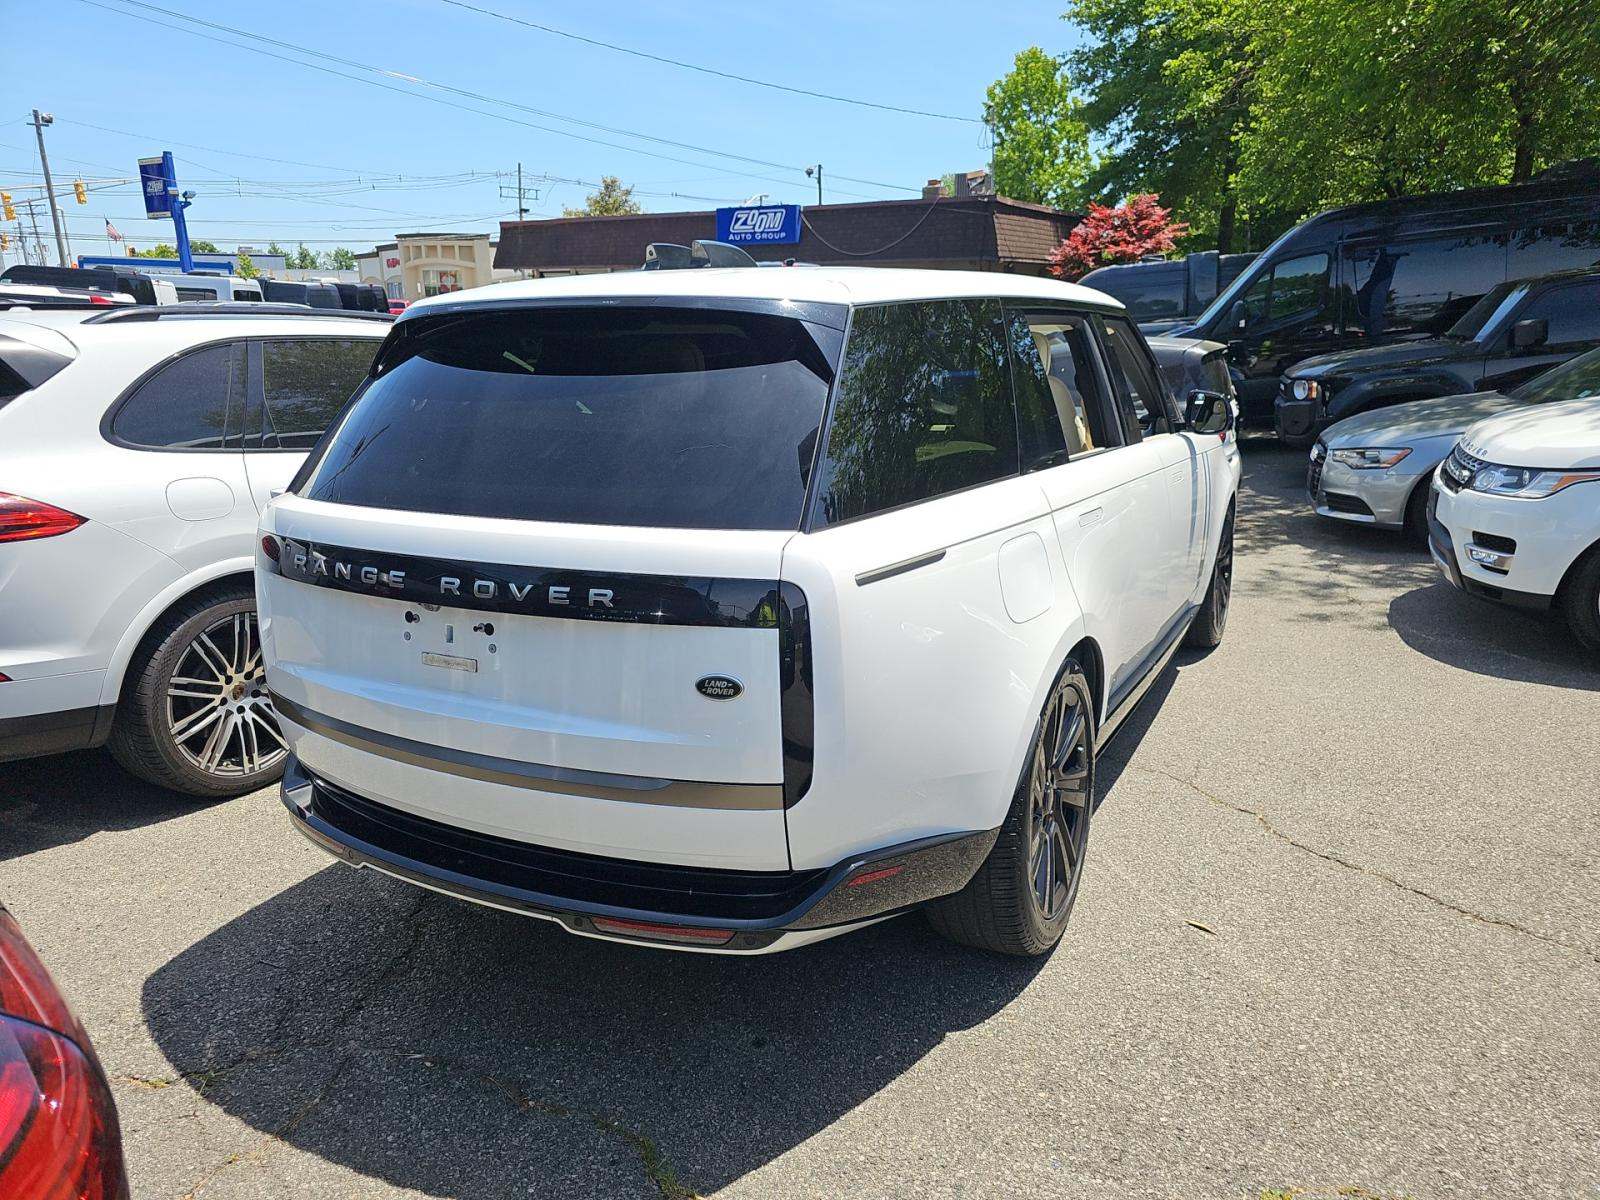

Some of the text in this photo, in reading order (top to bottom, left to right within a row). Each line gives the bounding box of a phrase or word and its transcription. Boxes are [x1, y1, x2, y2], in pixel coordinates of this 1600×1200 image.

[733, 209, 781, 232] ZOOM
[728, 232, 786, 241] AUTO GROUP
[293, 554, 614, 608] RANGE ROVER
